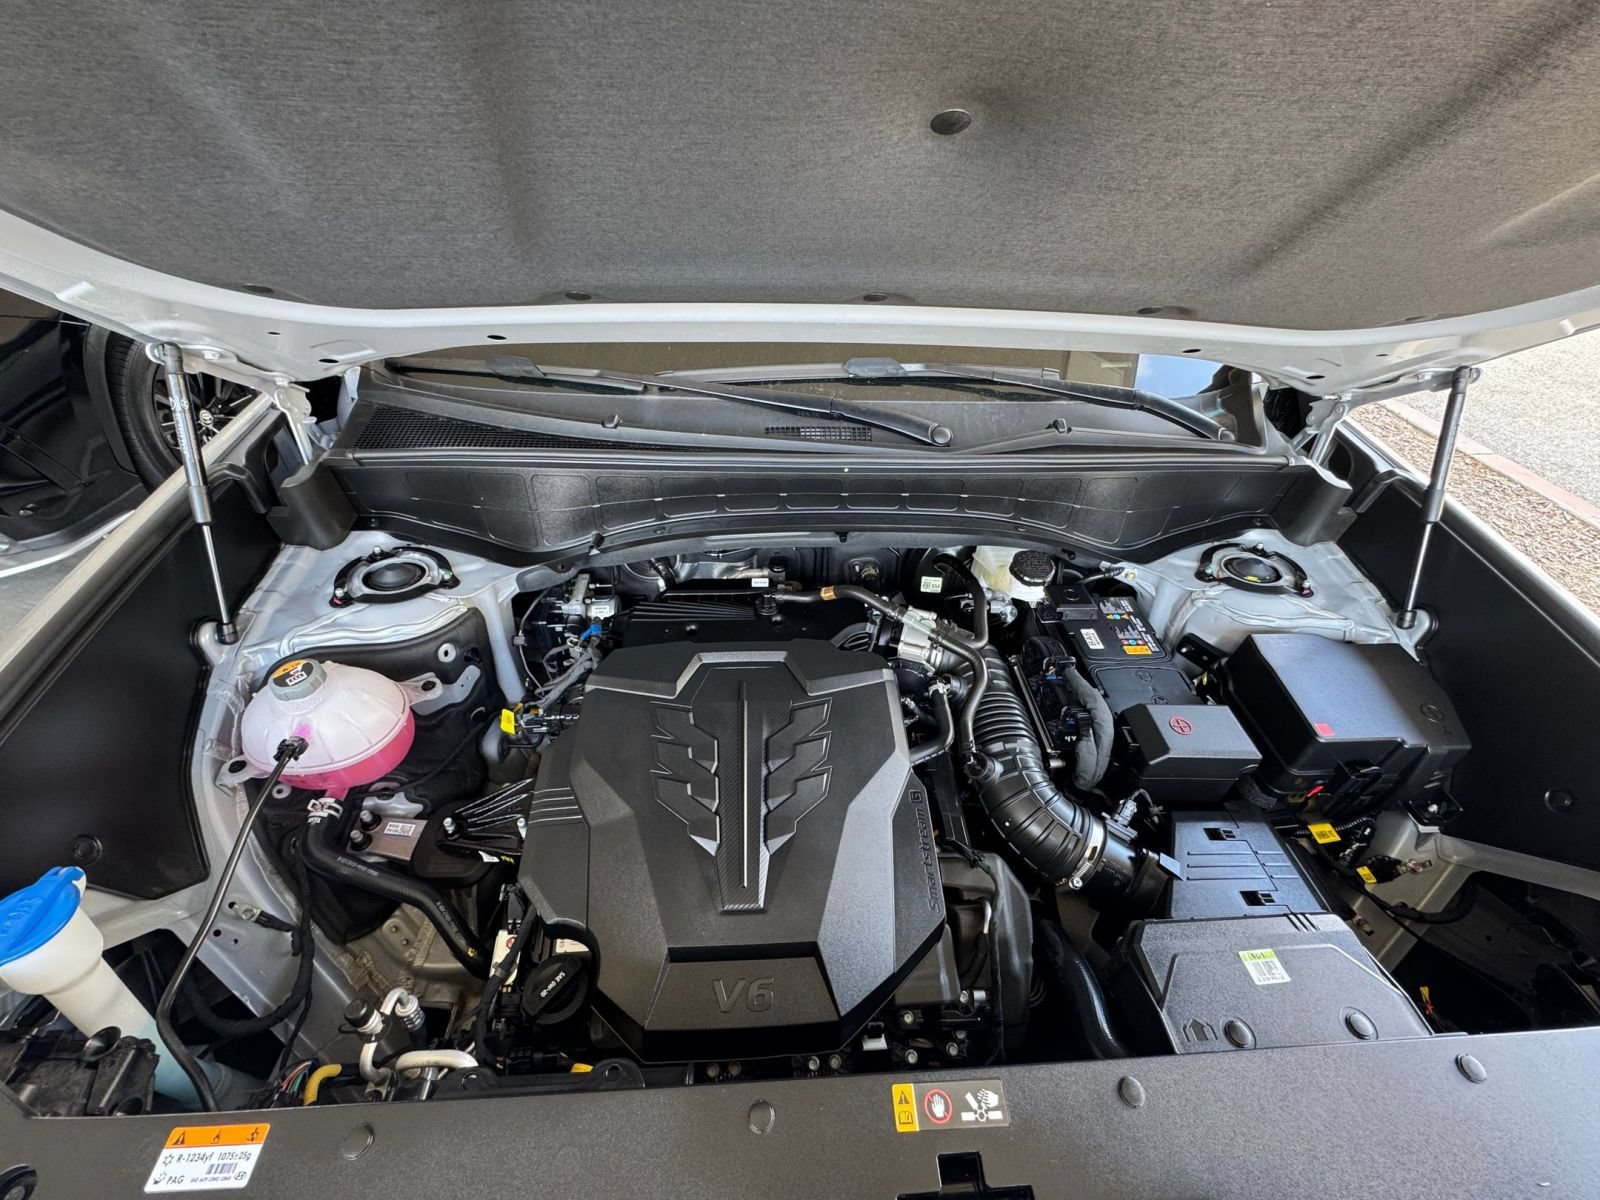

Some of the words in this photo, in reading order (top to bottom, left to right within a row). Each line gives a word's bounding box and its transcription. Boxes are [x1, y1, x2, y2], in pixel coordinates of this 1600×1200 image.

[915, 807, 939, 913] Smartstream
[554, 970, 566, 983] SAE
[540, 980, 557, 998] 0W-20
[712, 977, 775, 1013] V6
[176, 1152, 214, 1164] R-1234yf
[217, 1151, 252, 1162] 1075±25g
[166, 1175, 185, 1185] PAG
